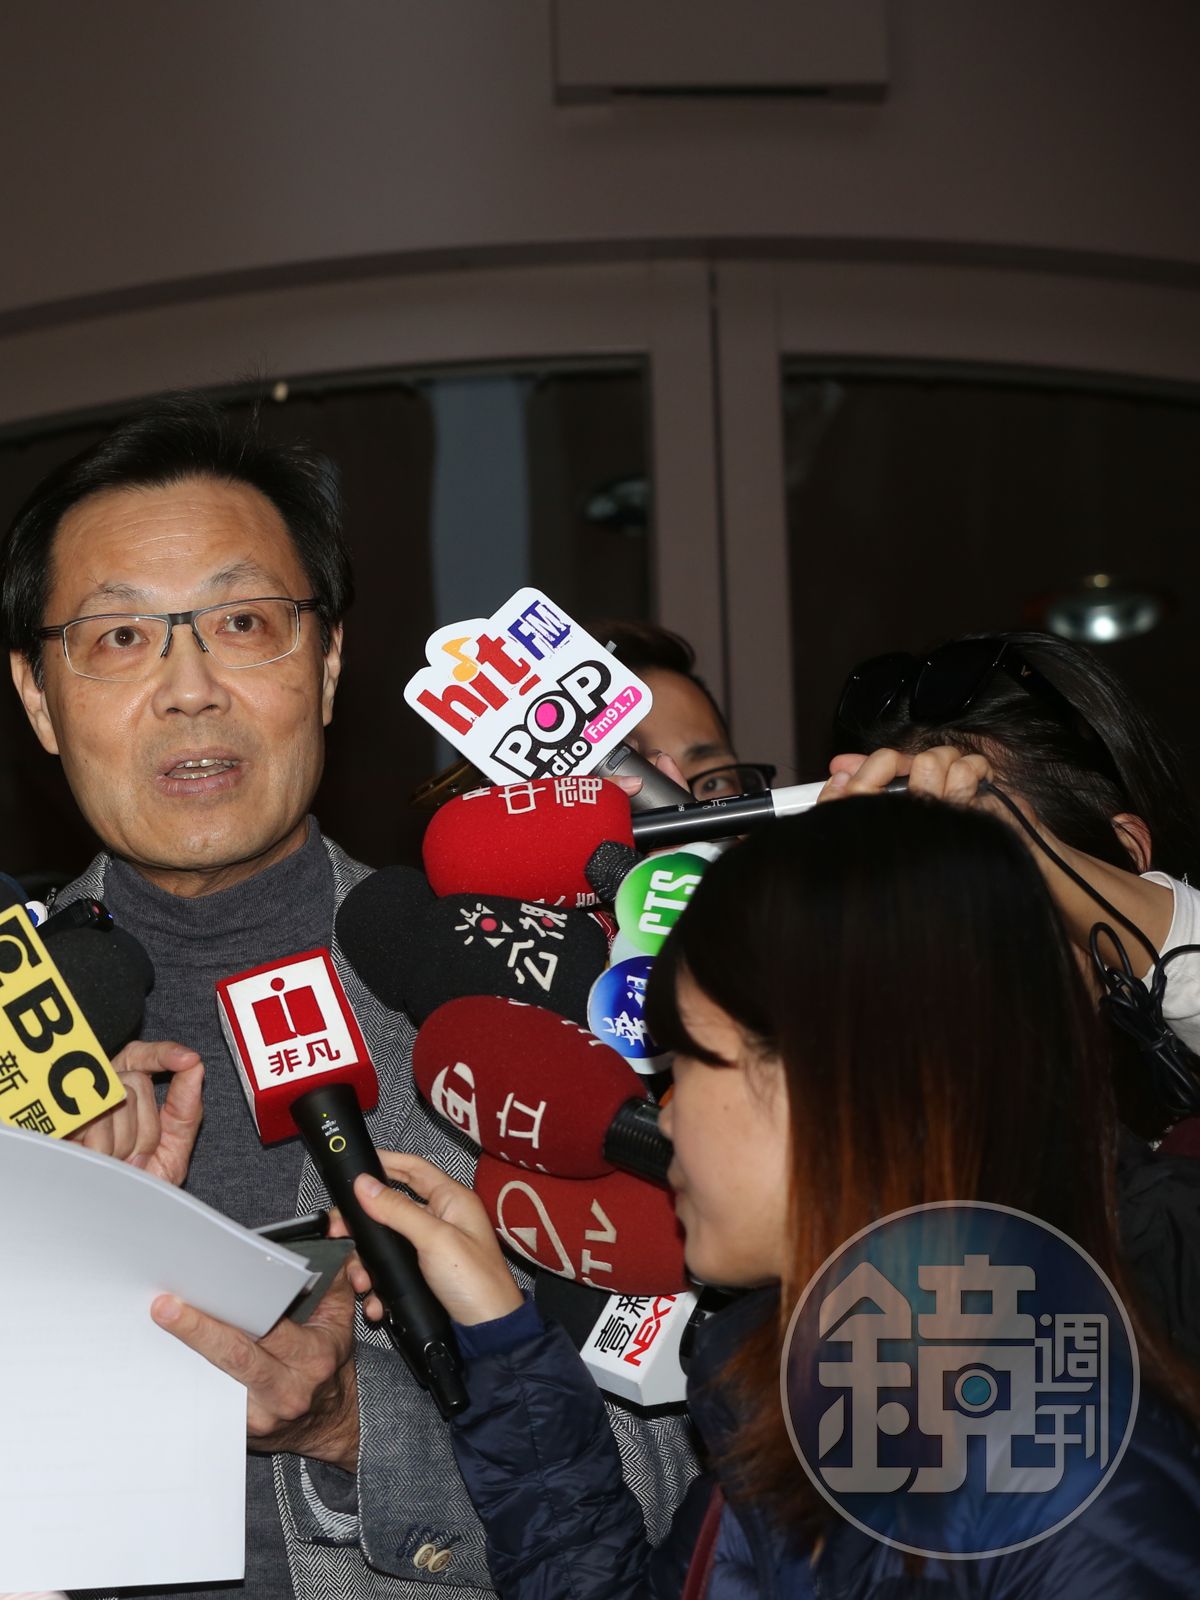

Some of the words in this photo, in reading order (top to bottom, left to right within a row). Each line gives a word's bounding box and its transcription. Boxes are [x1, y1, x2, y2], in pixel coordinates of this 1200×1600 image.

[416, 633, 532, 736] hit
[507, 600, 571, 661] FM
[489, 660, 612, 779] POP
[587, 689, 638, 740] Fm91.7
[268, 1039, 341, 1076] 非凡
